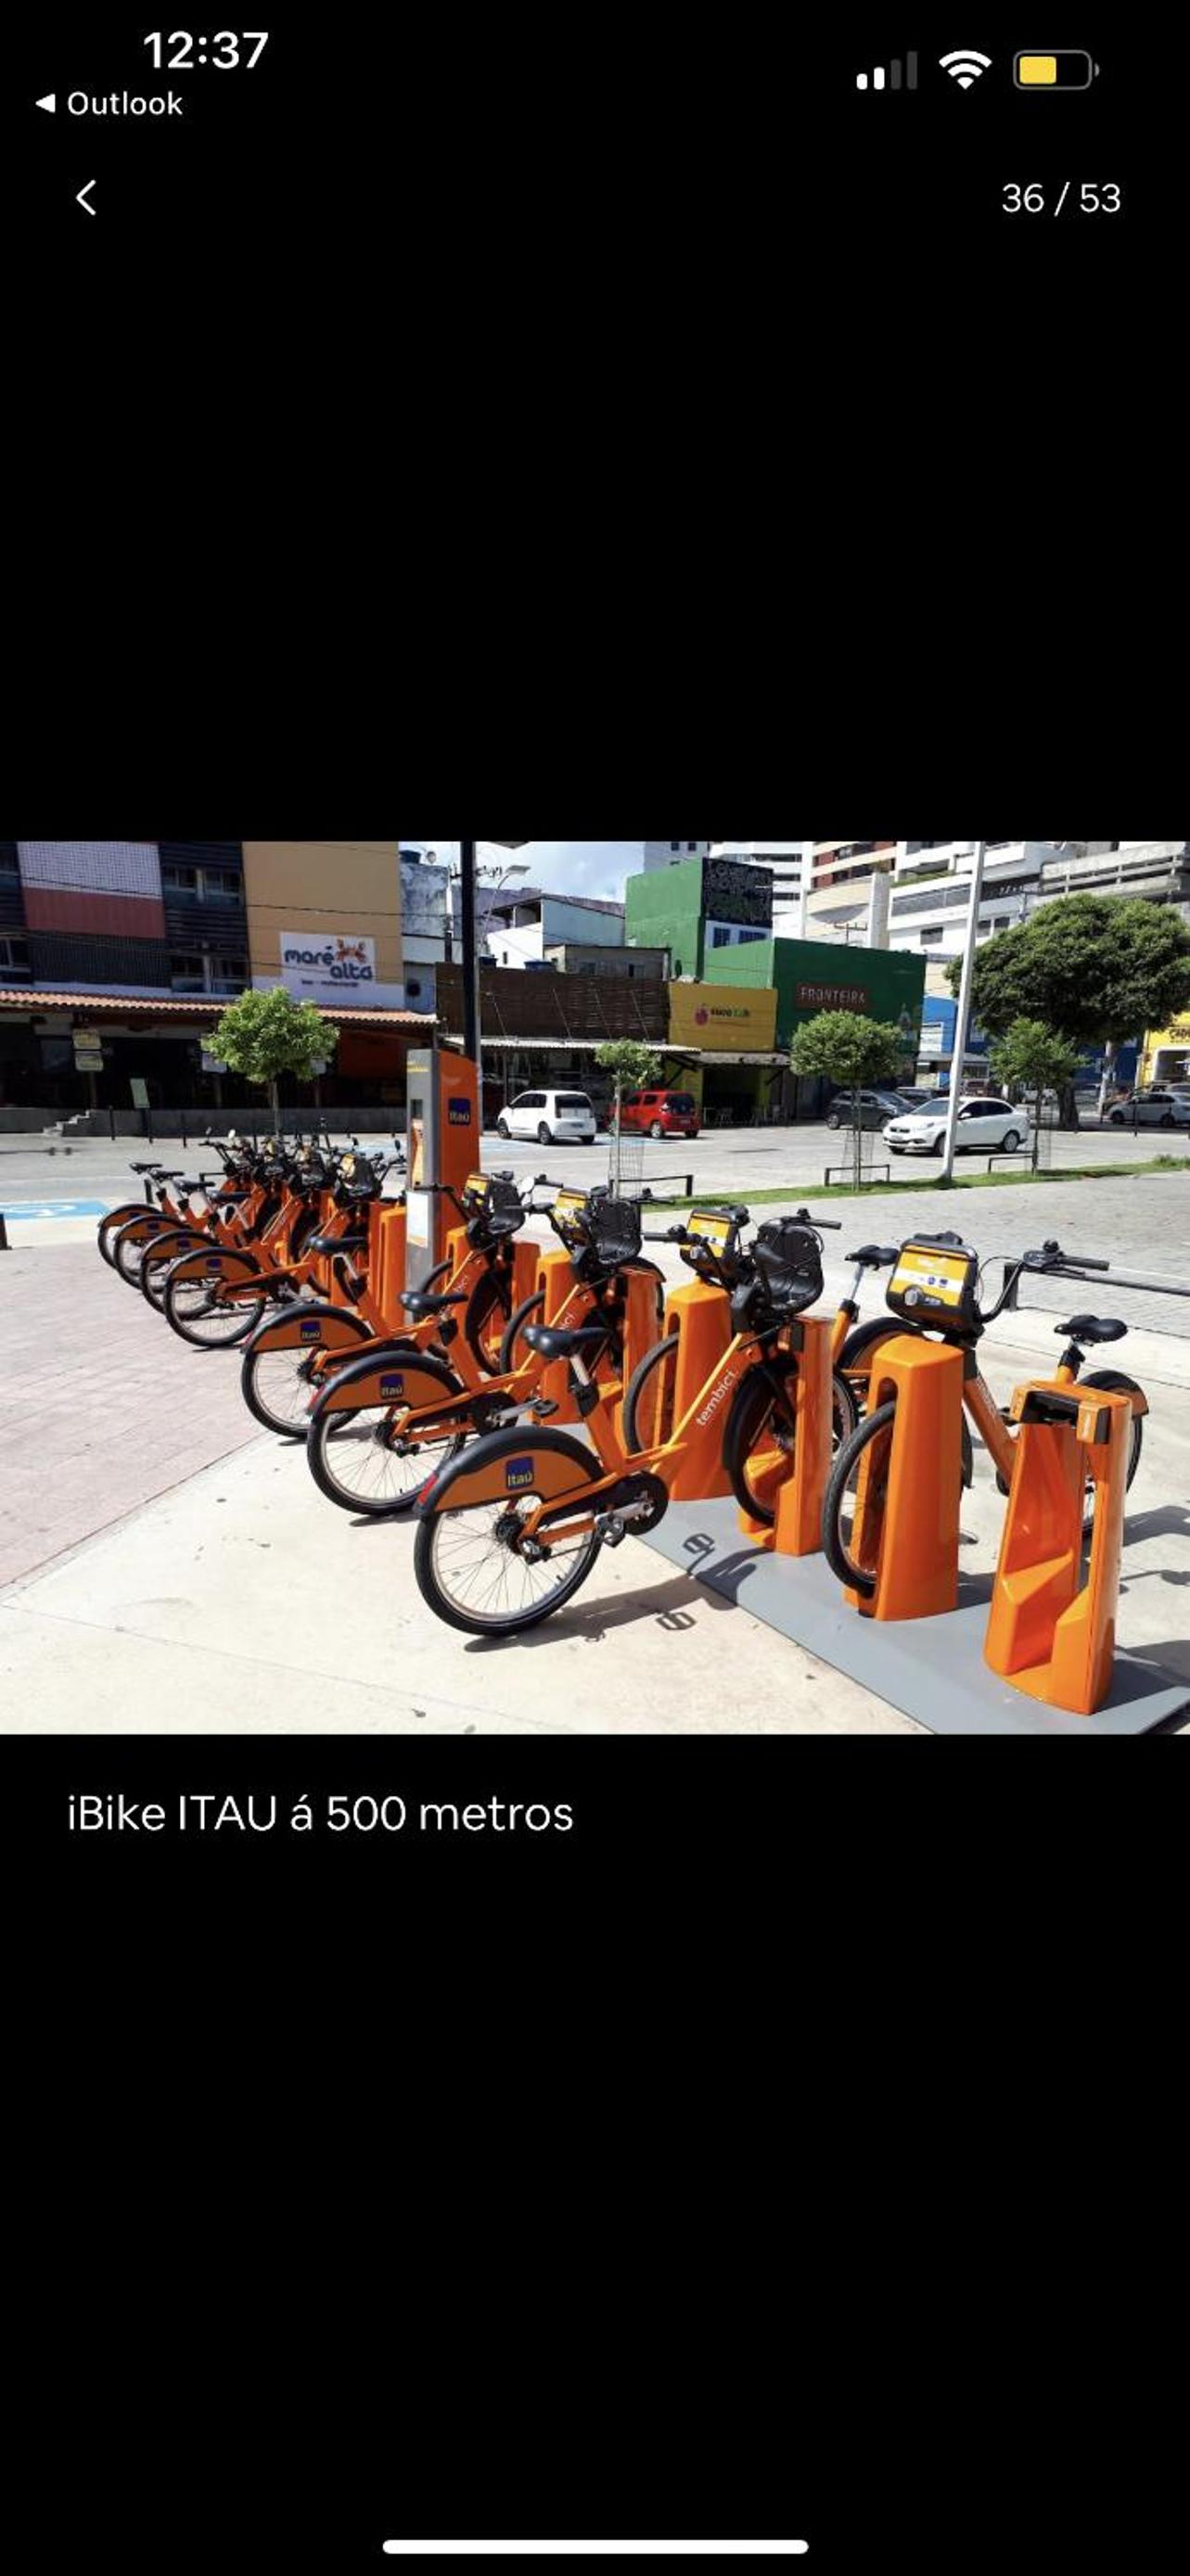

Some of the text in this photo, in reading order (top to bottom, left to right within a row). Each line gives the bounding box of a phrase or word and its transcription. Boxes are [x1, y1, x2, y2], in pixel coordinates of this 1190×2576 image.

[284, 945, 335, 965] maré
[329, 962, 373, 980] alta
[800, 986, 866, 1005] FRONTEIRA
[695, 1368, 736, 1426] tembici
